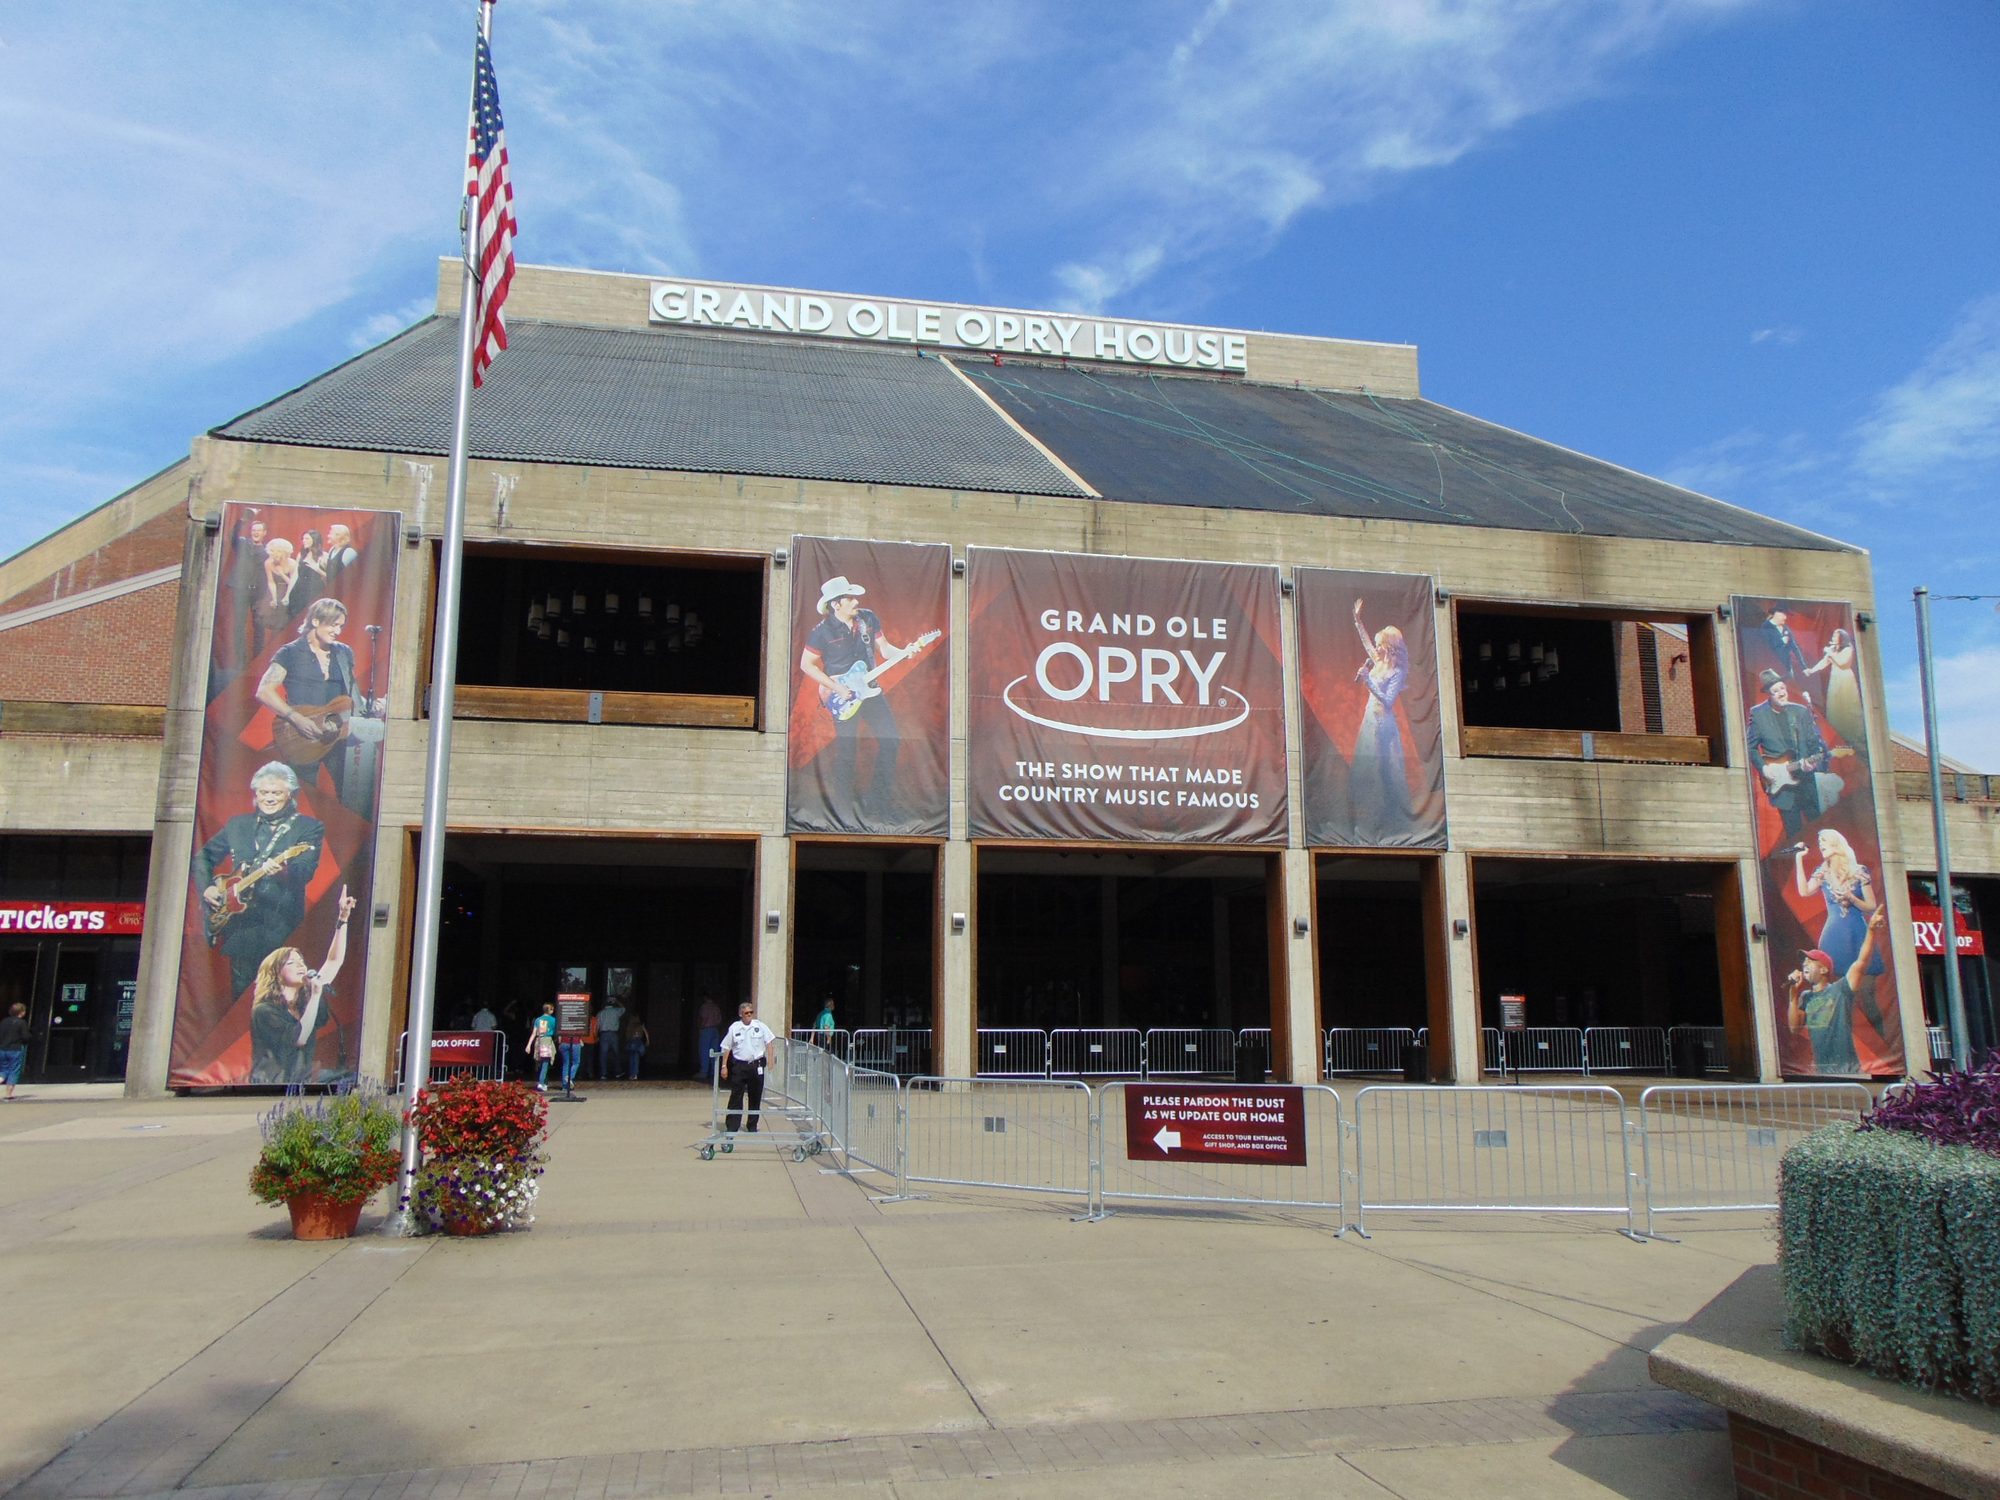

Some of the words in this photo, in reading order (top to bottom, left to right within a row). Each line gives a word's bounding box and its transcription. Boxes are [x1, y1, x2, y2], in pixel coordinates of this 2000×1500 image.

[652, 284, 834, 332] GRAND
[847, 301, 941, 343] OLE
[955, 312, 1082, 354] OPRY
[1094, 323, 1247, 372] HOUSE
[1040, 609, 1156, 636] GRAND
[1166, 616, 1227, 640] OLE
[1035, 641, 1227, 705] OPRY
[1015, 761, 1055, 778] THE
[1061, 763, 1123, 780] SHOW
[1128, 765, 1180, 782] THAT
[1185, 767, 1243, 785] MADE
[998, 784, 1099, 804] COUNTRY
[1104, 788, 1170, 806] MUSIC
[1176, 790, 1260, 809] FAMOUS
[1955, 935, 1973, 948] OP
[431, 1039, 449, 1048] BOX
[450, 1039, 480, 1048] OFFICE
[1143, 1096, 1181, 1106] PLEASE
[1183, 1097, 1229, 1107] PARDON
[1231, 1098, 1253, 1108] THE
[1256, 1099, 1285, 1109] DUST
[1144, 1110, 1158, 1120] AS
[1159, 1110, 1176, 1120] WE
[1178, 1111, 1220, 1121] UPDATE
[1222, 1112, 1247, 1122] OUR
[1250, 1112, 1285, 1123] HOME
